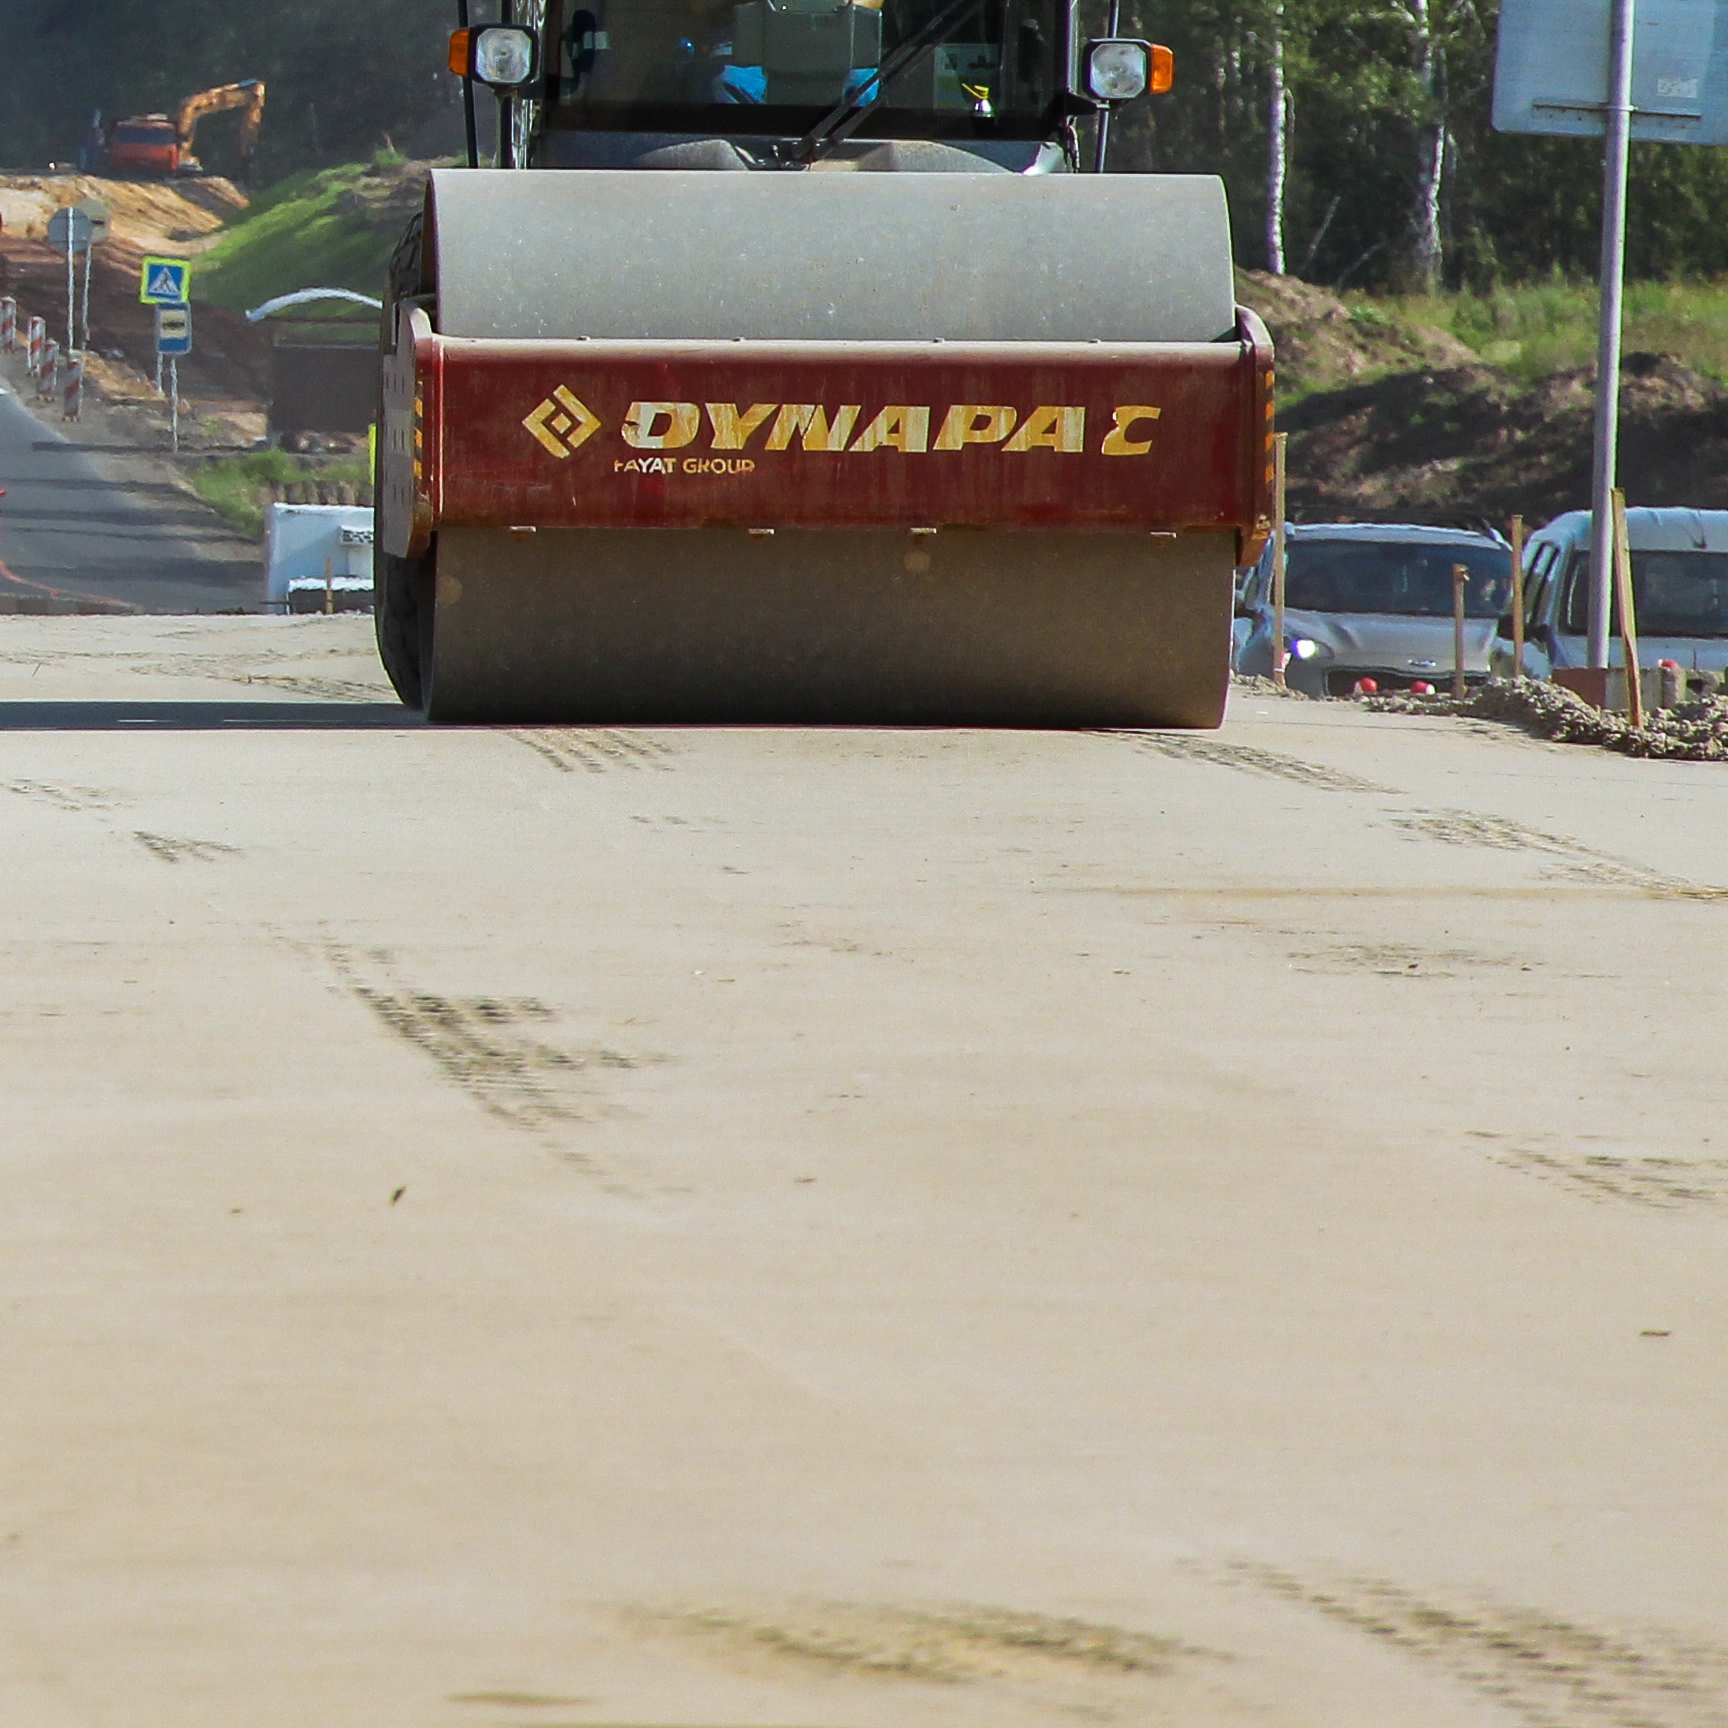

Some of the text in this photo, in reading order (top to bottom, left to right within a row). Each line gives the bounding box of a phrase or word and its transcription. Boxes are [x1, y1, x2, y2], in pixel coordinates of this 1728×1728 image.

[621, 401, 1162, 456] DYNAPAC
[613, 457, 756, 474] FAYAT GROUP
